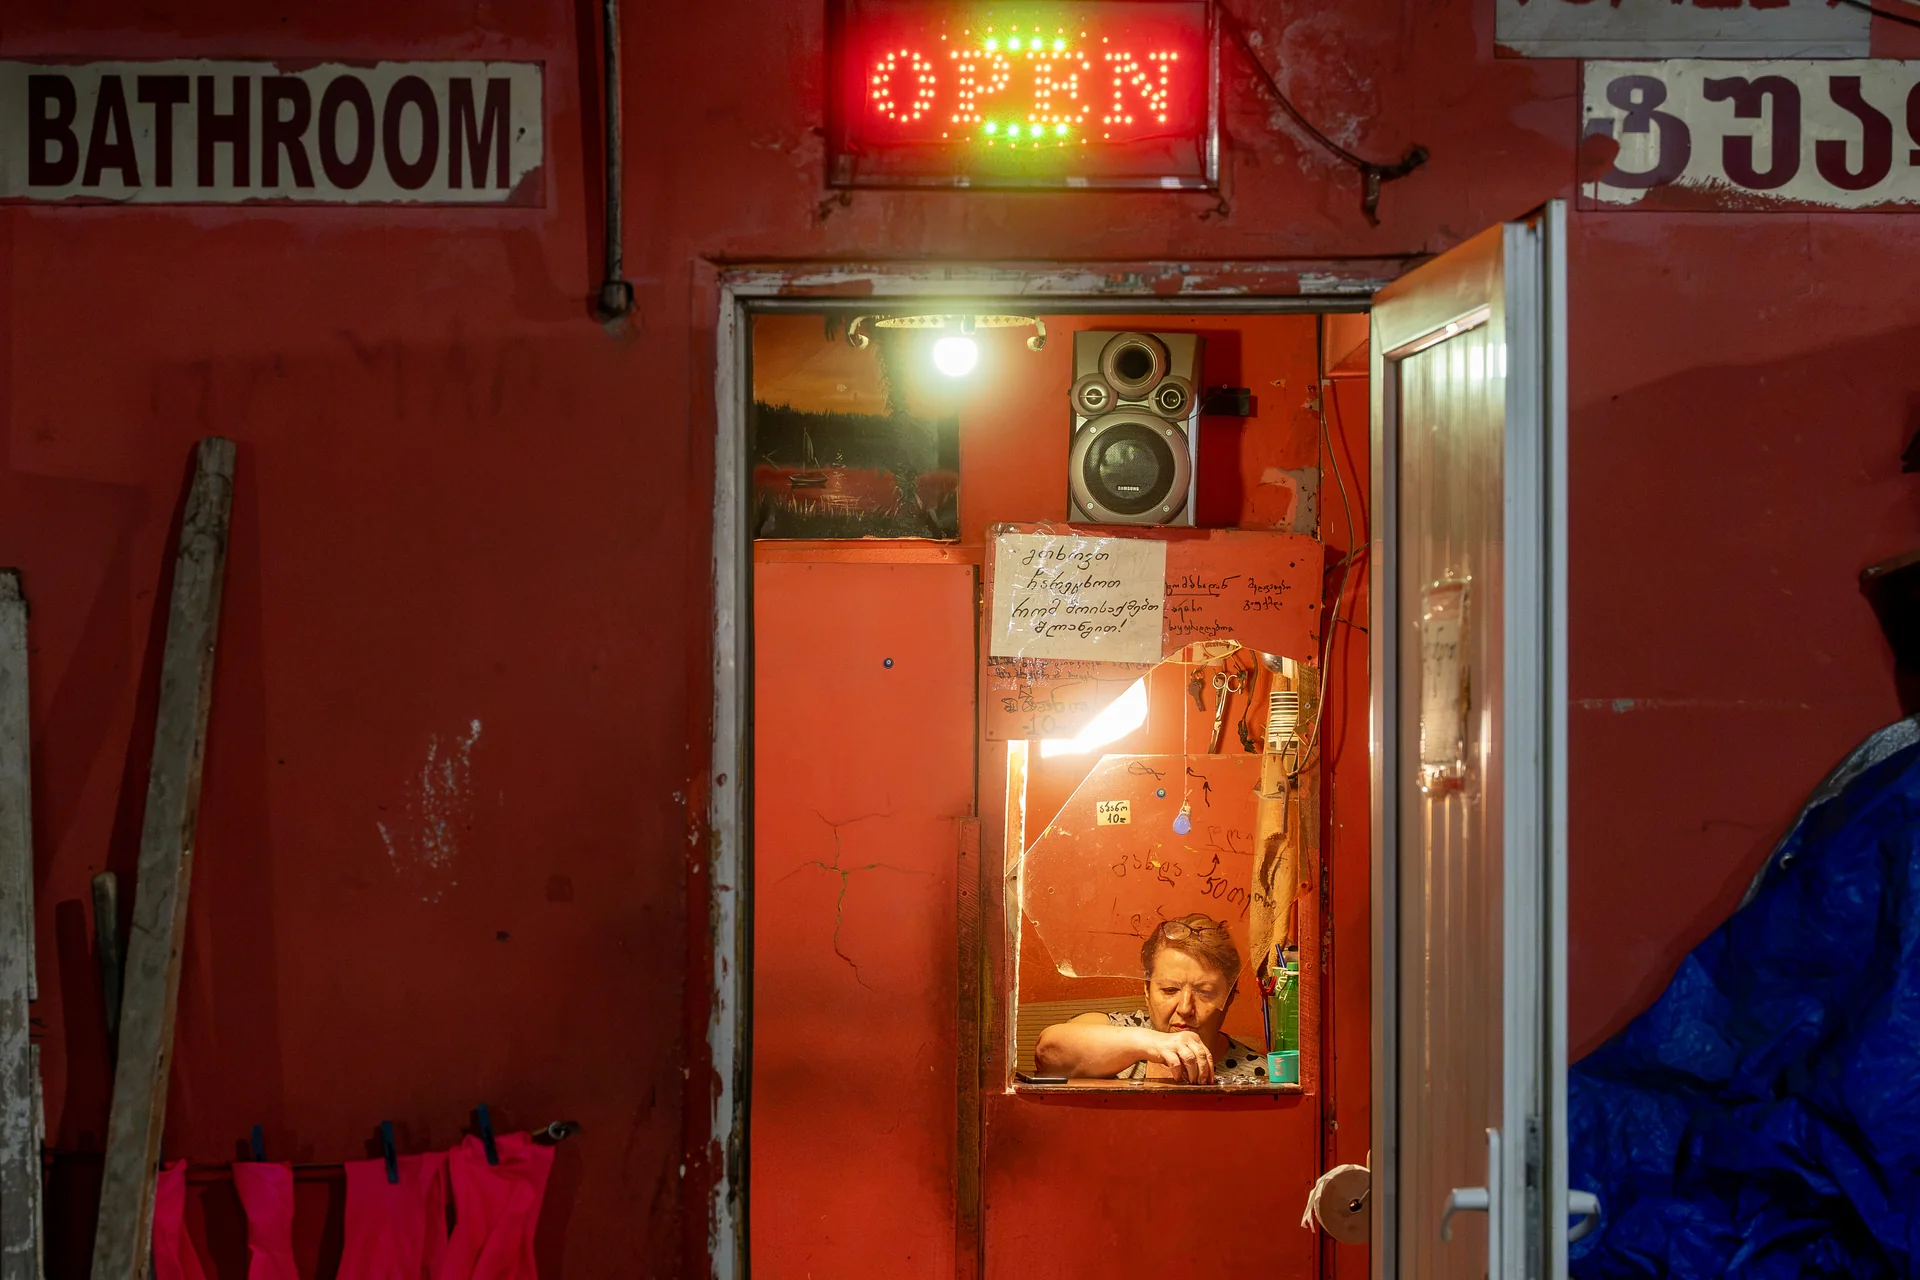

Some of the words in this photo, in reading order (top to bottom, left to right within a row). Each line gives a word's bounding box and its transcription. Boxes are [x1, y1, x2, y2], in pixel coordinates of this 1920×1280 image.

[872, 48, 1179, 124] OPEN
[28, 74, 511, 190] BATHROOM
[1583, 74, 1920, 191] ტუა
[1021, 545, 1110, 570] გთხოვთ
[1011, 597, 1062, 618] რომ
[1034, 618, 1128, 639] შლანგით!
[1099, 801, 1128, 814] აბანო
[1201, 876, 1228, 900] 50
